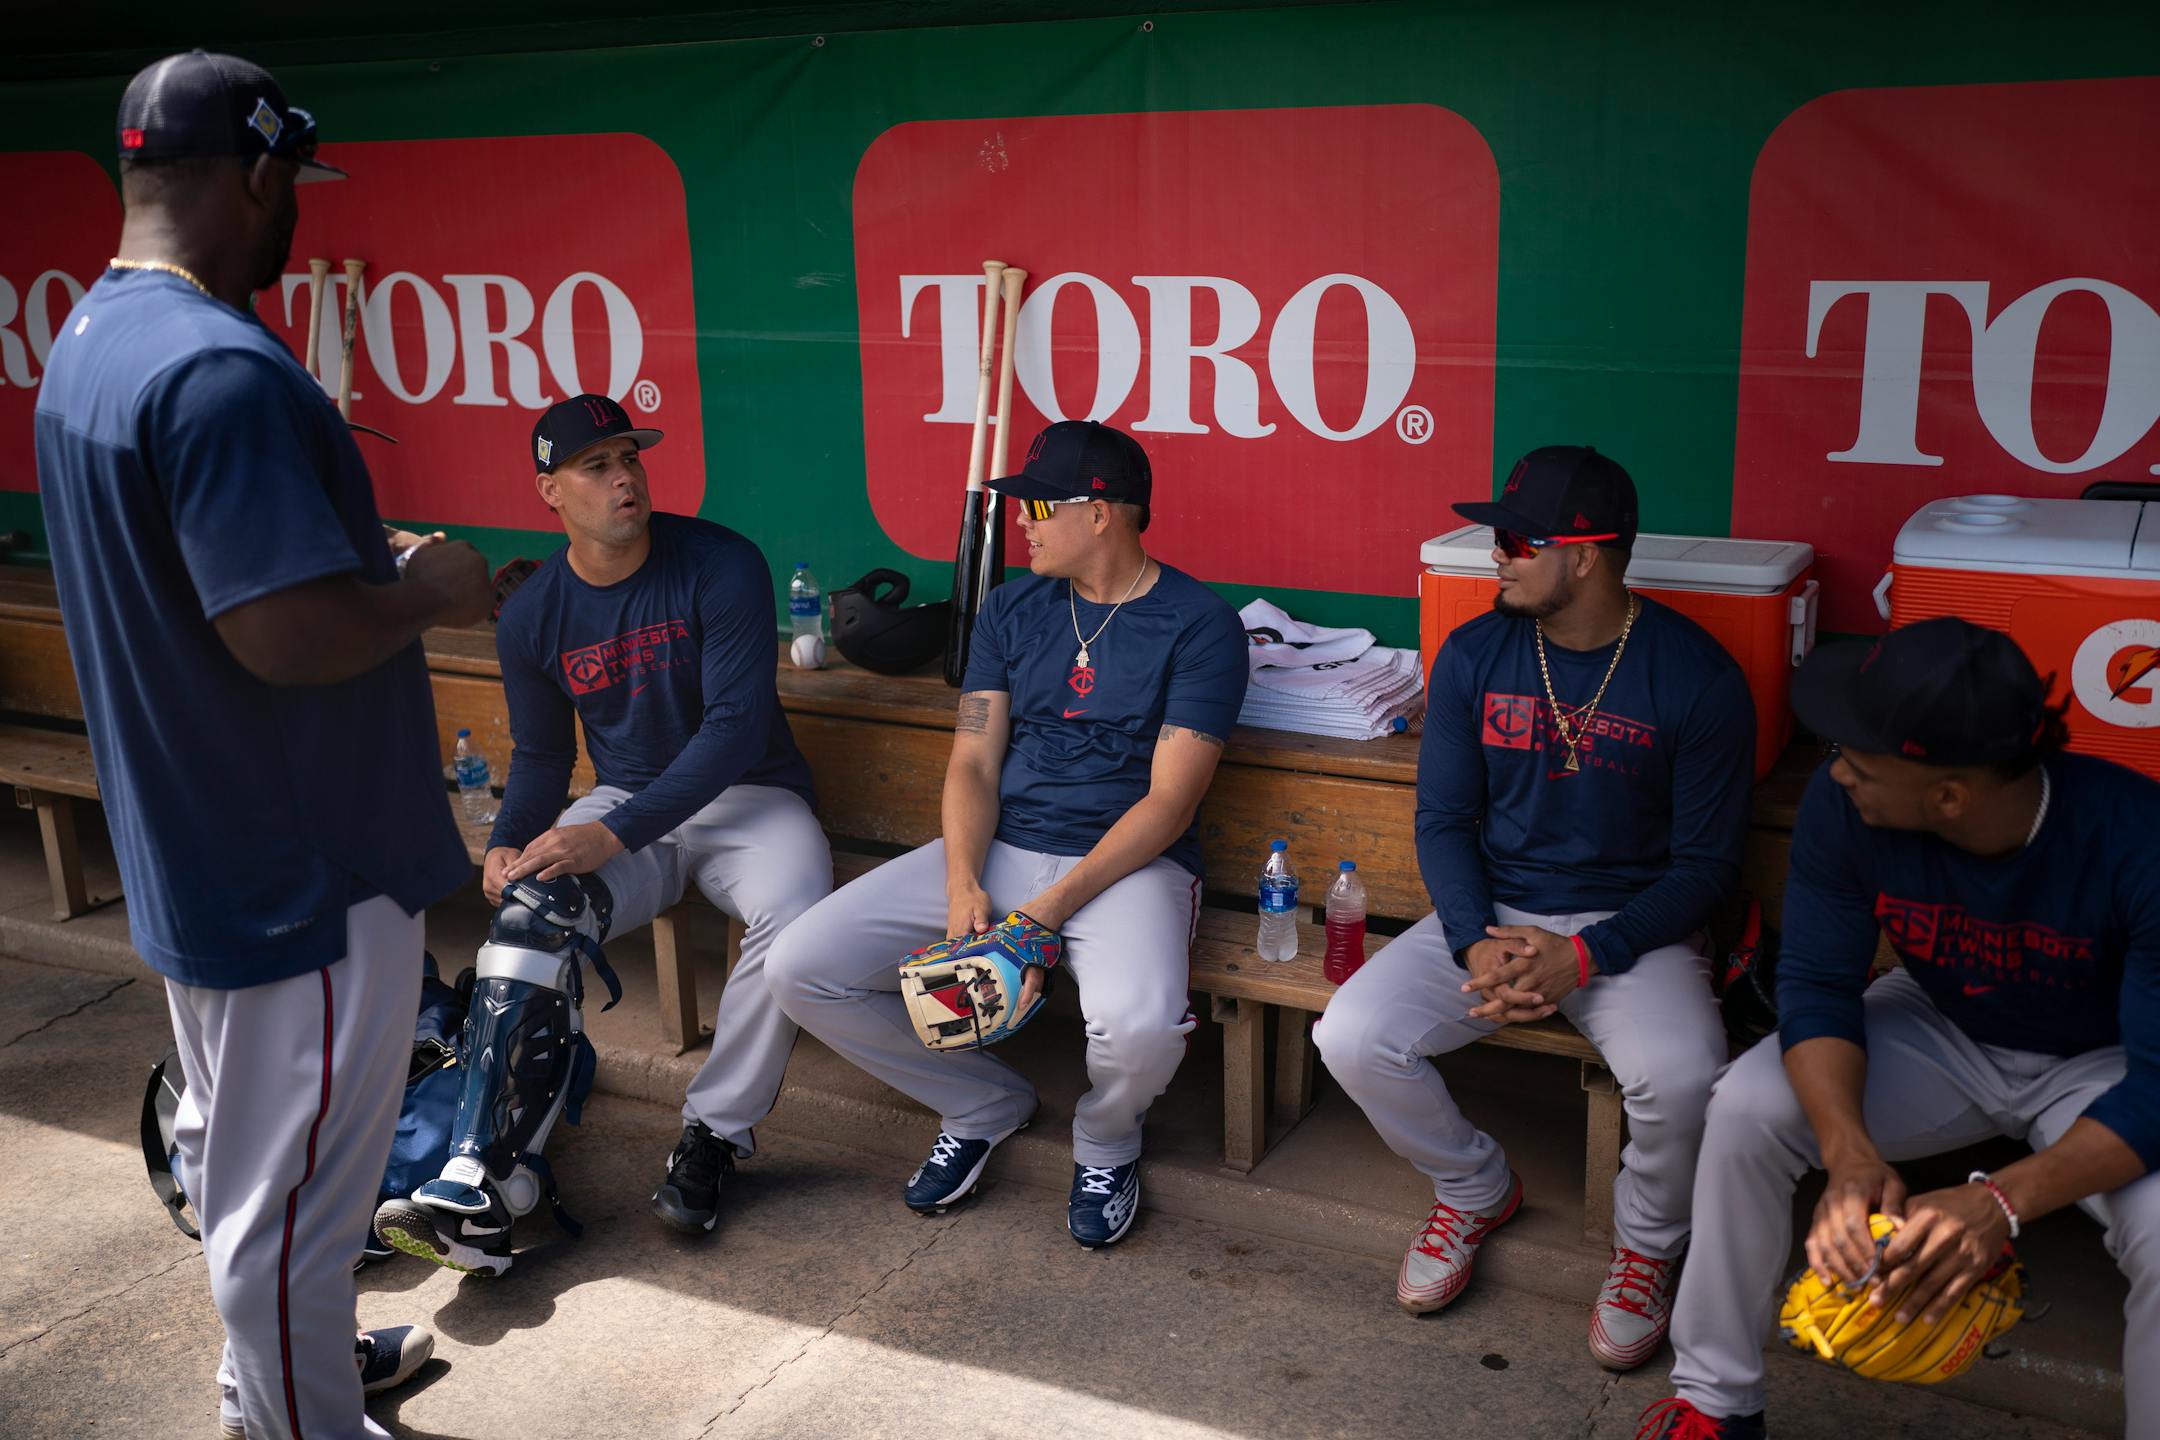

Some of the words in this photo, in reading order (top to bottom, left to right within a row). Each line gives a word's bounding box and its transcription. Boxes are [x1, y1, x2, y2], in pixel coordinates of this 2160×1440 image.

[281, 271, 644, 410] TORO
[899, 272, 1416, 441] TORO
[1806, 277, 2160, 476] TO
[608, 648, 655, 675] TWNS
[1535, 704, 1653, 748] MINESOTA
[1535, 723, 1594, 752] TWS
[1941, 1324, 1981, 1375] A2000
